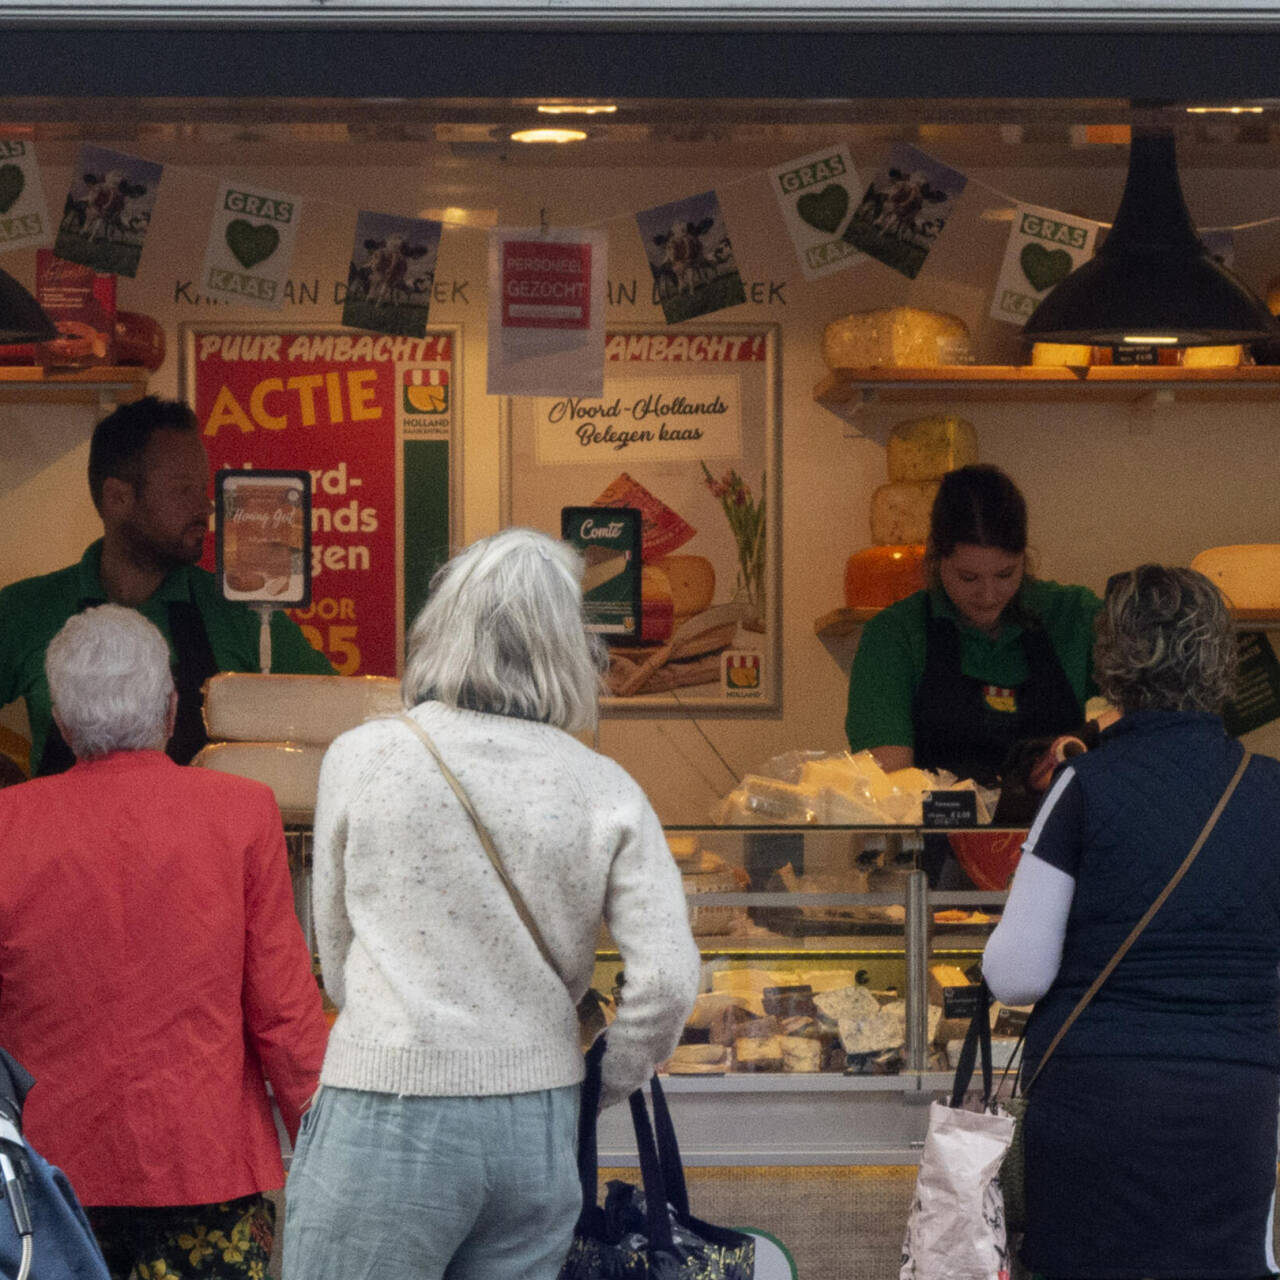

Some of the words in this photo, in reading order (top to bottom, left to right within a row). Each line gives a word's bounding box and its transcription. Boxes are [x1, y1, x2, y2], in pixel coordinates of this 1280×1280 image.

[780, 154, 847, 195] GRAS
[224, 190, 294, 223] GRAS
[1020, 214, 1088, 249] GRAS
[507, 258, 582, 272] PERSONEEL
[207, 268, 278, 301] KAAS
[507, 280, 584, 298] GEZOCHT
[200, 336, 282, 362] PUUR
[203, 369, 383, 437] ACTIE
[576, 421, 655, 451] Belegen
[659, 424, 704, 442] kaas
